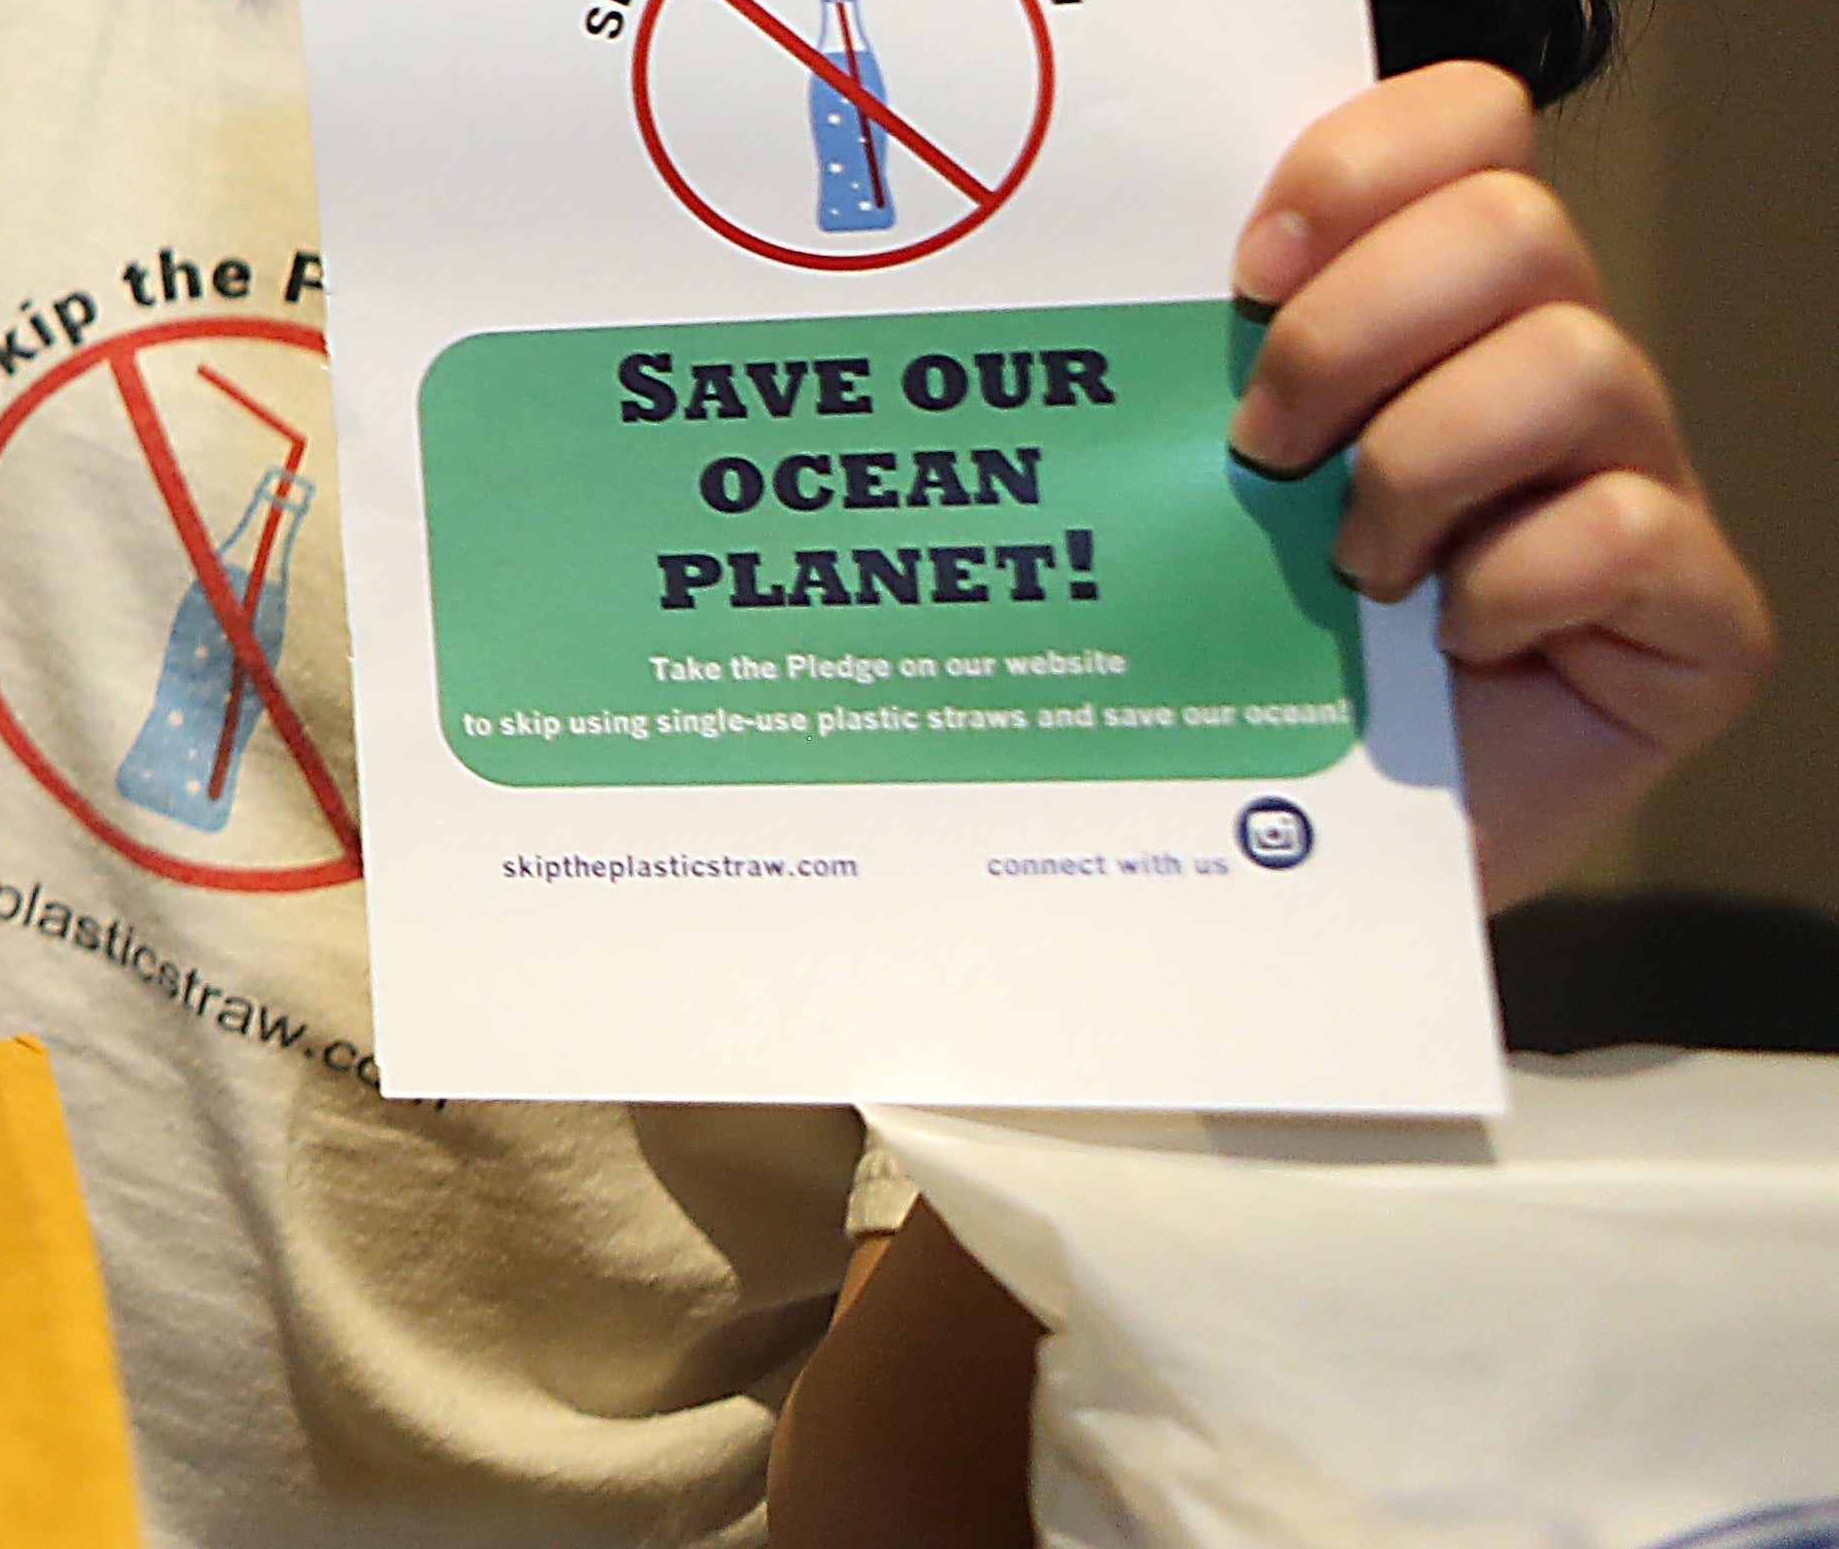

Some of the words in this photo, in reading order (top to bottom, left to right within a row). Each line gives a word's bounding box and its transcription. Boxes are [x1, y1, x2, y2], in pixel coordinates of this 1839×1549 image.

[121, 249, 252, 307] the
[618, 352, 874, 423] SAVE
[902, 348, 1117, 412] OUR
[699, 447, 1042, 514] OCEAN
[656, 528, 1100, 610] PLANET!
[649, 655, 722, 682] Take
[729, 655, 779, 681] the
[785, 654, 893, 686] Pledge
[898, 656, 937, 679] on
[945, 656, 998, 678] our
[1004, 649, 1129, 677] website
[462, 712, 492, 737] to
[501, 710, 562, 741] skip
[569, 710, 651, 740] using
[656, 708, 808, 739] single-use
[817, 705, 921, 738] plastic
[927, 705, 1029, 731] straws
[1037, 702, 1097, 729] and
[1103, 705, 1177, 728] save
[1182, 703, 1237, 726] our
[1243, 698, 1352, 726] ocean!
[502, 854, 859, 883] skiptheplasticstraw.com
[987, 853, 1107, 877] connect
[1117, 852, 1183, 876] with
[1194, 857, 1230, 876] us
